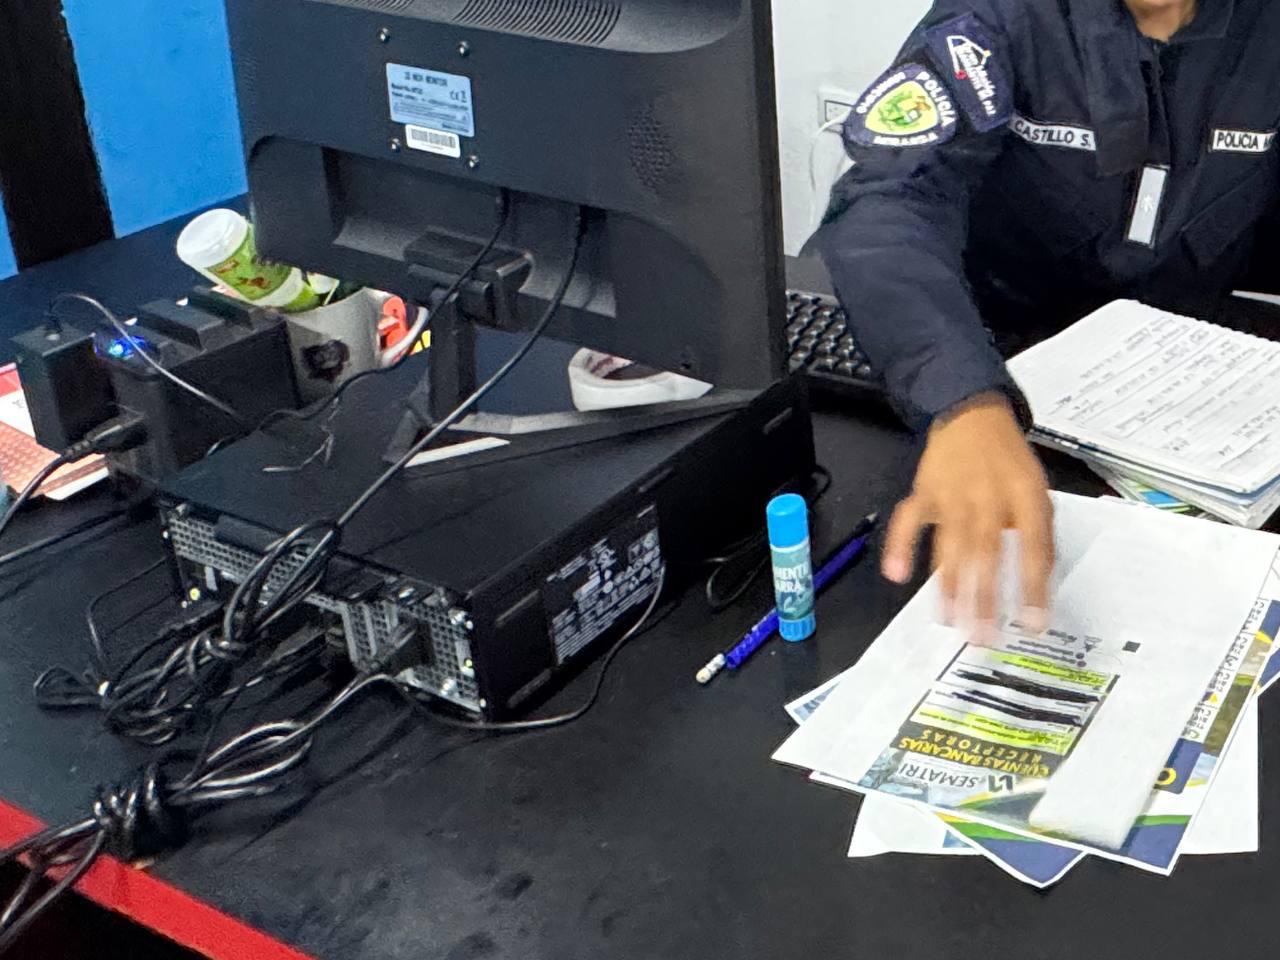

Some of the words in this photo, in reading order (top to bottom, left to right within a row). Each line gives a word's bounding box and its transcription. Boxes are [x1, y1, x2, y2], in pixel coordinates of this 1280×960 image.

[1014, 120, 1074, 144] CASTILLO
[1217, 131, 1258, 149] POLICIA
[899, 737, 983, 766] BANCARIAS
[922, 728, 1043, 763] RECEPTORAS
[899, 763, 979, 788] SEMATRI
[983, 755, 1050, 778] CUENTAS
